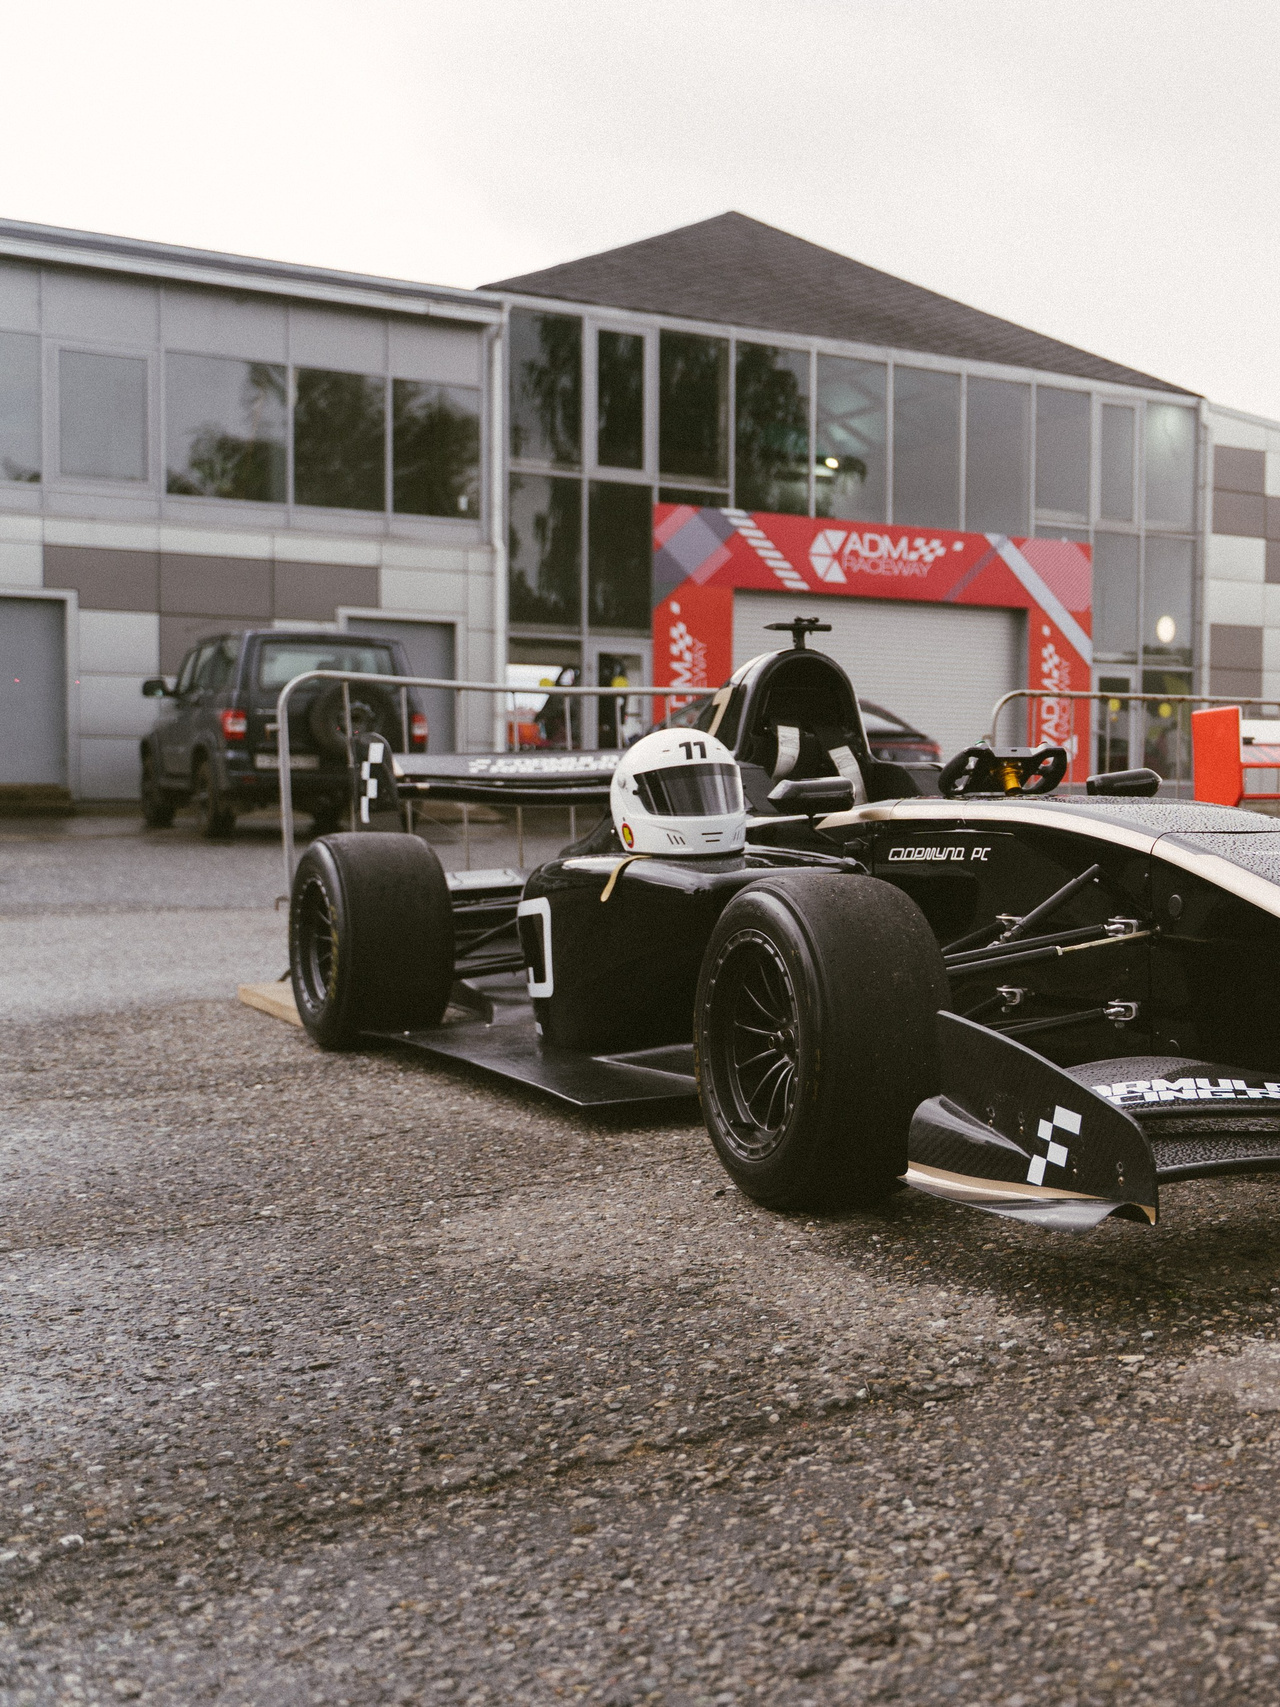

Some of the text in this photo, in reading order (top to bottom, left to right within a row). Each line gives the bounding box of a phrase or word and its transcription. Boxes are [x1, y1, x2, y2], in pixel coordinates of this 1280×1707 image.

[844, 531, 909, 560] ADM
[843, 554, 932, 577] RACEWAY
[678, 741, 707, 761] 11
